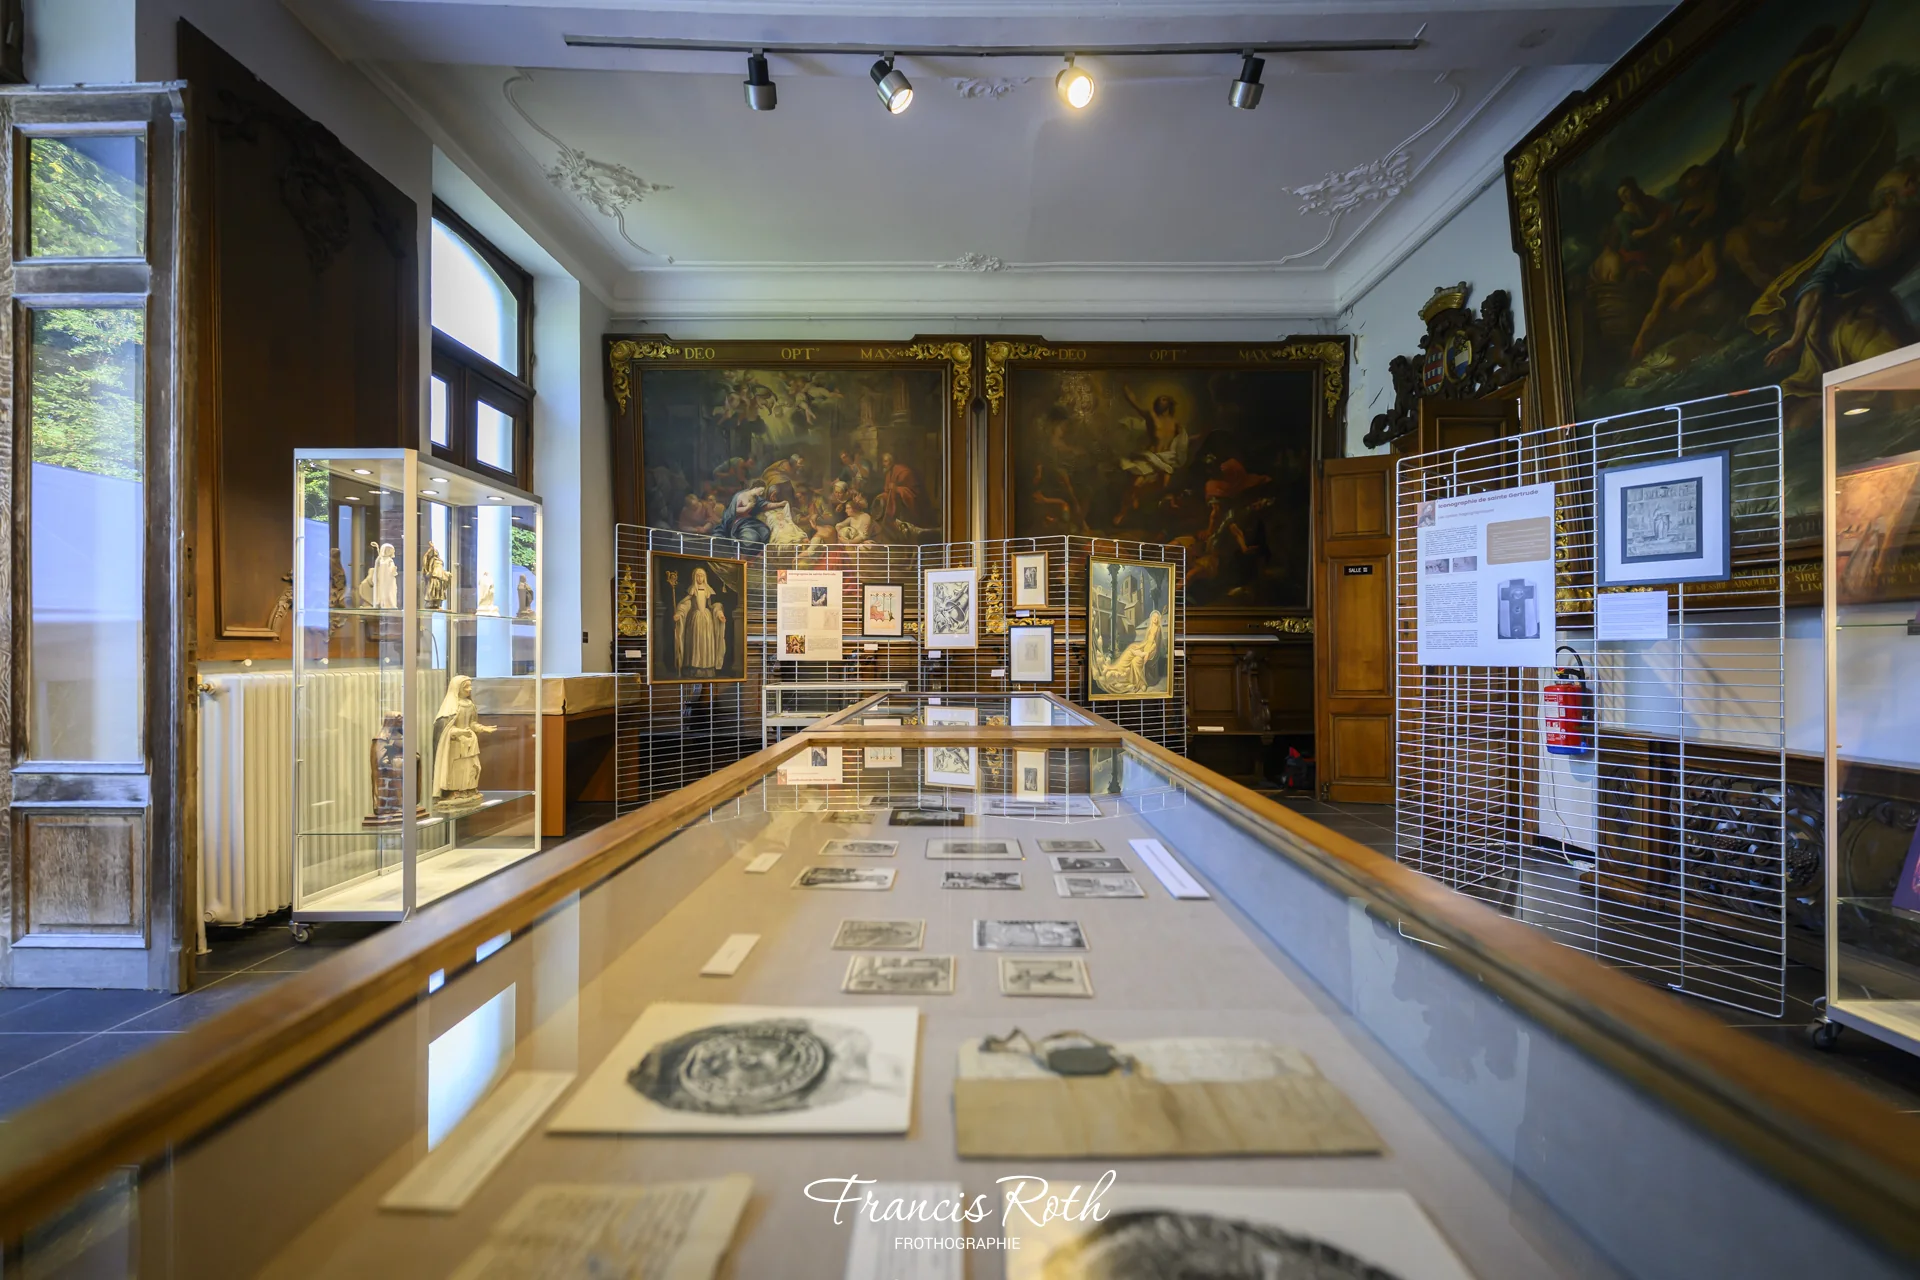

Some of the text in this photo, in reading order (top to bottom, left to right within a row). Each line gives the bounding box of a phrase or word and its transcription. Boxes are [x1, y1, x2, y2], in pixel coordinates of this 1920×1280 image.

[684, 347, 716, 360] DEO
[860, 348, 897, 360] MAX
[1058, 348, 1087, 361] DEO
[1238, 349, 1270, 361] MAX
[1487, 493, 1508, 502] sainte
[1508, 488, 1539, 498] Gertrude
